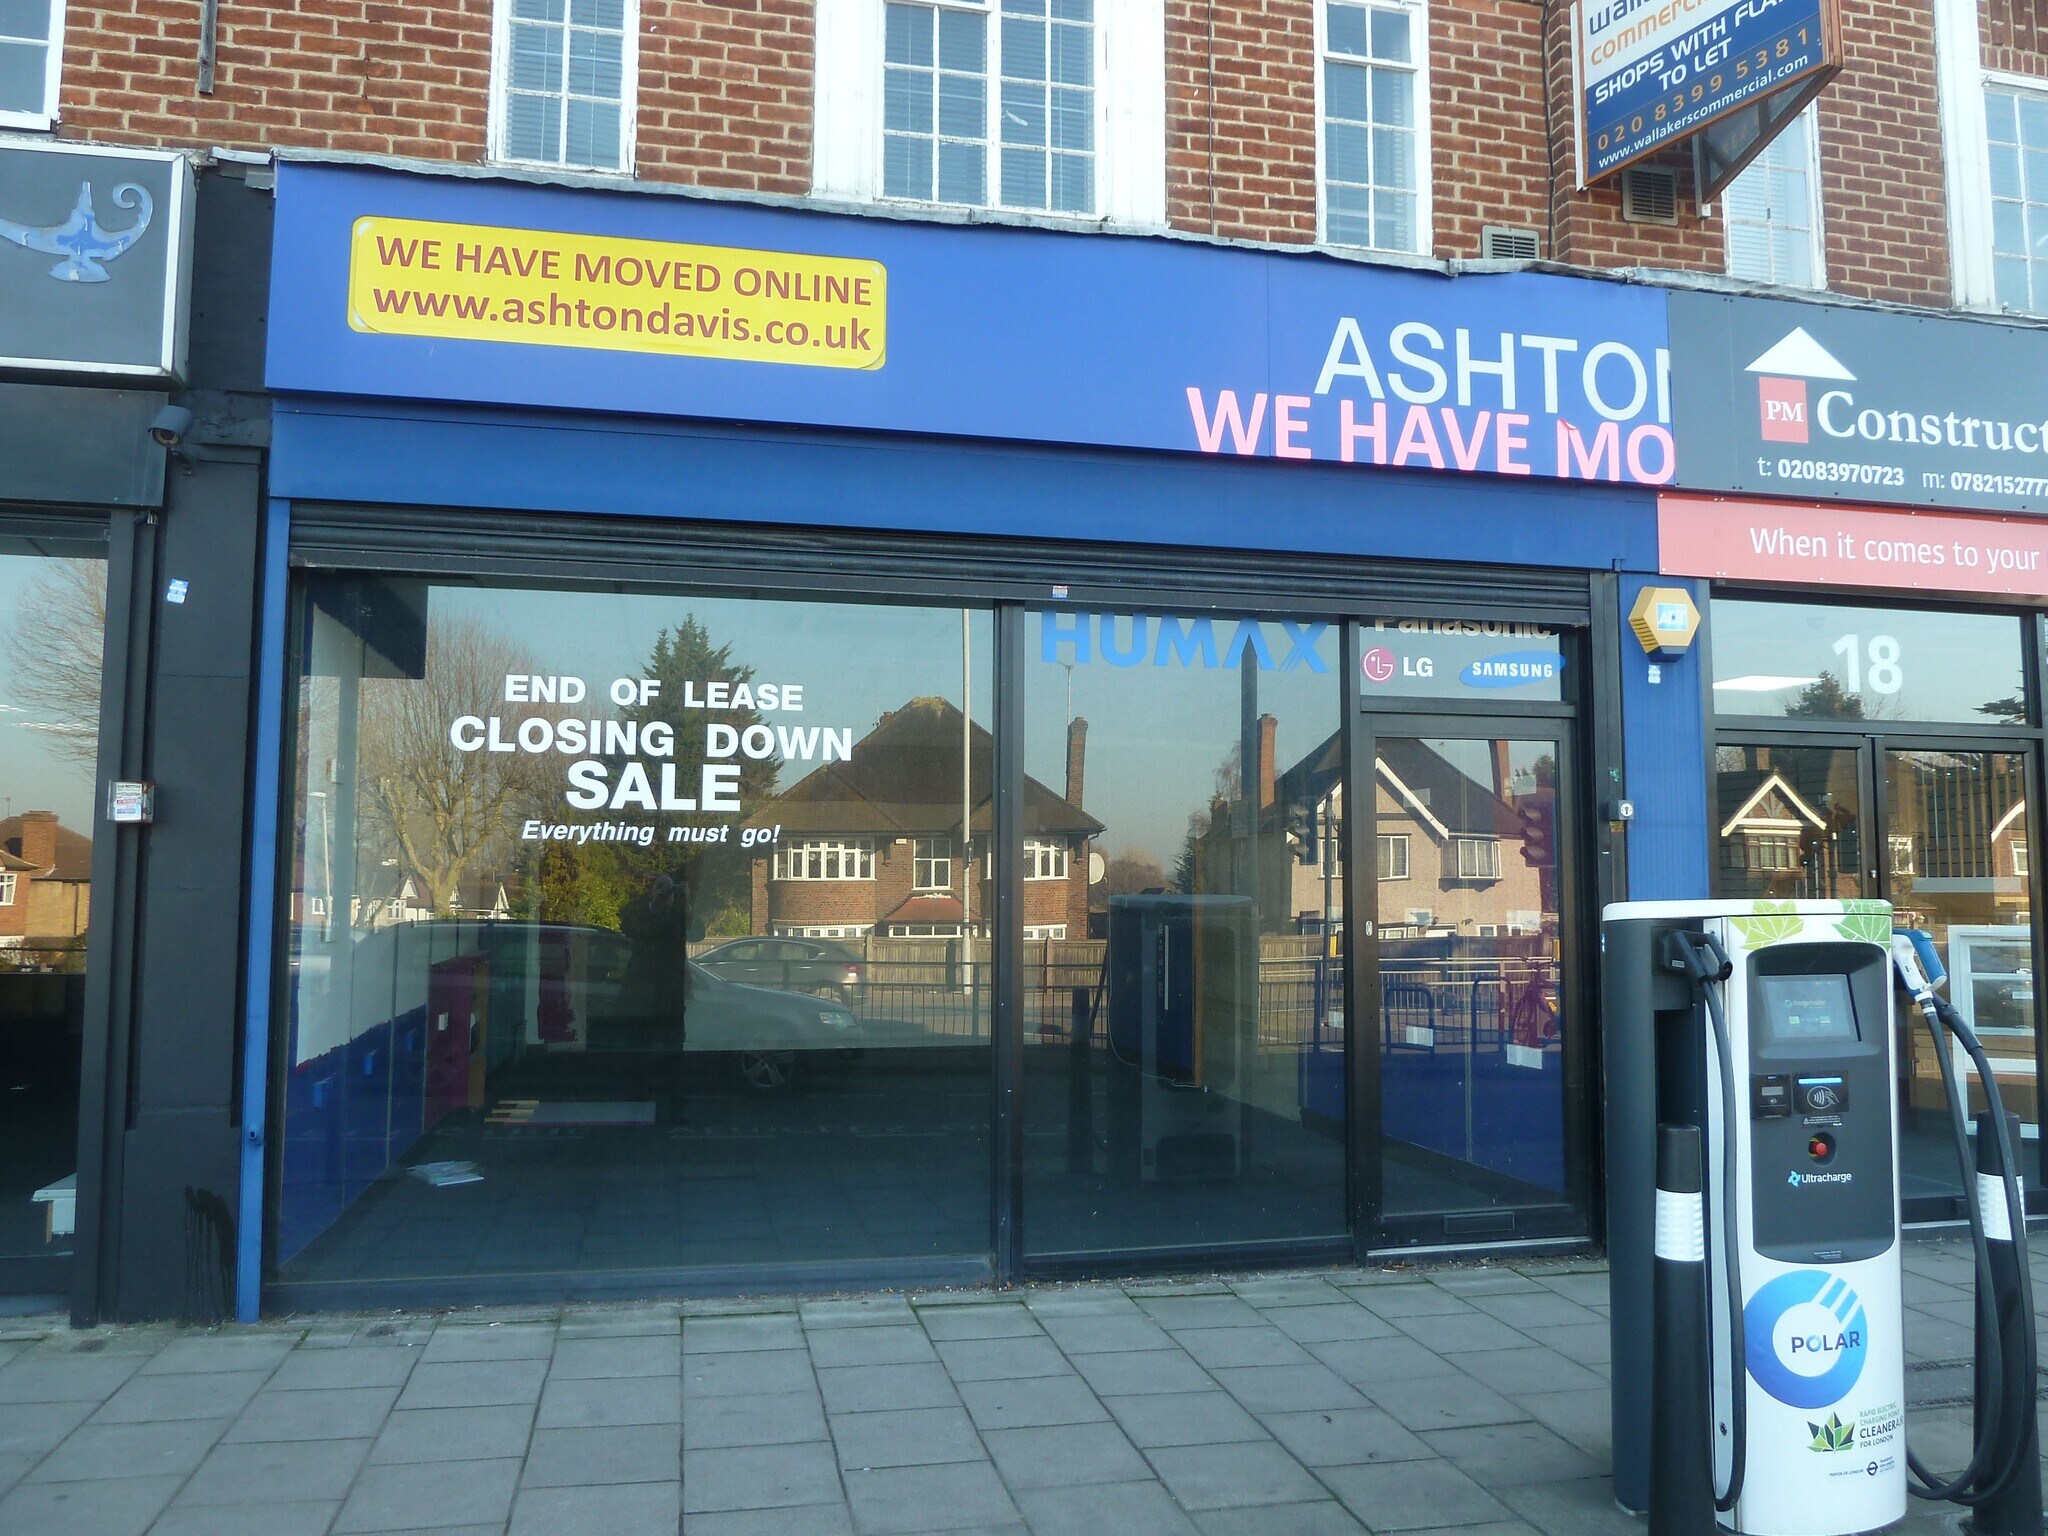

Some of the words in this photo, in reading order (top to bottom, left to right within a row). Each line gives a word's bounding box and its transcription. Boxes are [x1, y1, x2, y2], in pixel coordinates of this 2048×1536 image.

[1596, 52, 1664, 104] SHOPS
[1670, 17, 1726, 62] WITH
[1658, 65, 1686, 92] TO
[1694, 37, 1732, 73] LET
[1598, 116, 1643, 150] 020
[1655, 74, 1722, 121] 8399
[1736, 28, 1808, 80] 5381
[1598, 54, 1808, 168] www.wallakerscommercial.com
[376, 236, 442, 270] WE
[456, 243, 560, 280] HAVE
[575, 254, 720, 292] MOVED
[734, 268, 872, 307] ONLINE
[372, 288, 871, 350] www.ashtondavis.co.uk
[1314, 317, 1670, 424] ASHTO
[1186, 387, 1312, 459] WE
[1340, 400, 1531, 475] HAVE
[1556, 419, 1675, 485] MO
[1766, 400, 1804, 423] PM
[1758, 456, 1772, 476] t:
[1778, 458, 1904, 486] 02083970723
[1922, 472, 1945, 490] m:
[1750, 528, 1827, 558] When
[1837, 532, 1854, 560] it
[1864, 538, 1945, 565] comes
[1953, 541, 1978, 567] to
[1986, 548, 2040, 574] your
[1041, 609, 1329, 673] HUMAX
[1832, 634, 1903, 694] 18
[1402, 657, 1434, 677] LG
[1472, 662, 1553, 678] SAMSUNG
[505, 674, 586, 704] END
[610, 678, 661, 706] OF
[684, 680, 804, 711] LEASE
[450, 716, 674, 756] CLOSING
[706, 723, 852, 762] DOWN
[566, 760, 741, 812] SALE
[522, 820, 654, 846] Everything
[668, 824, 728, 843] must
[742, 824, 780, 848] go!
[1802, 1173, 1852, 1183] Ultracharge
[1792, 1331, 1860, 1353] POLAR
[1873, 1434, 1894, 1446] LONDON
